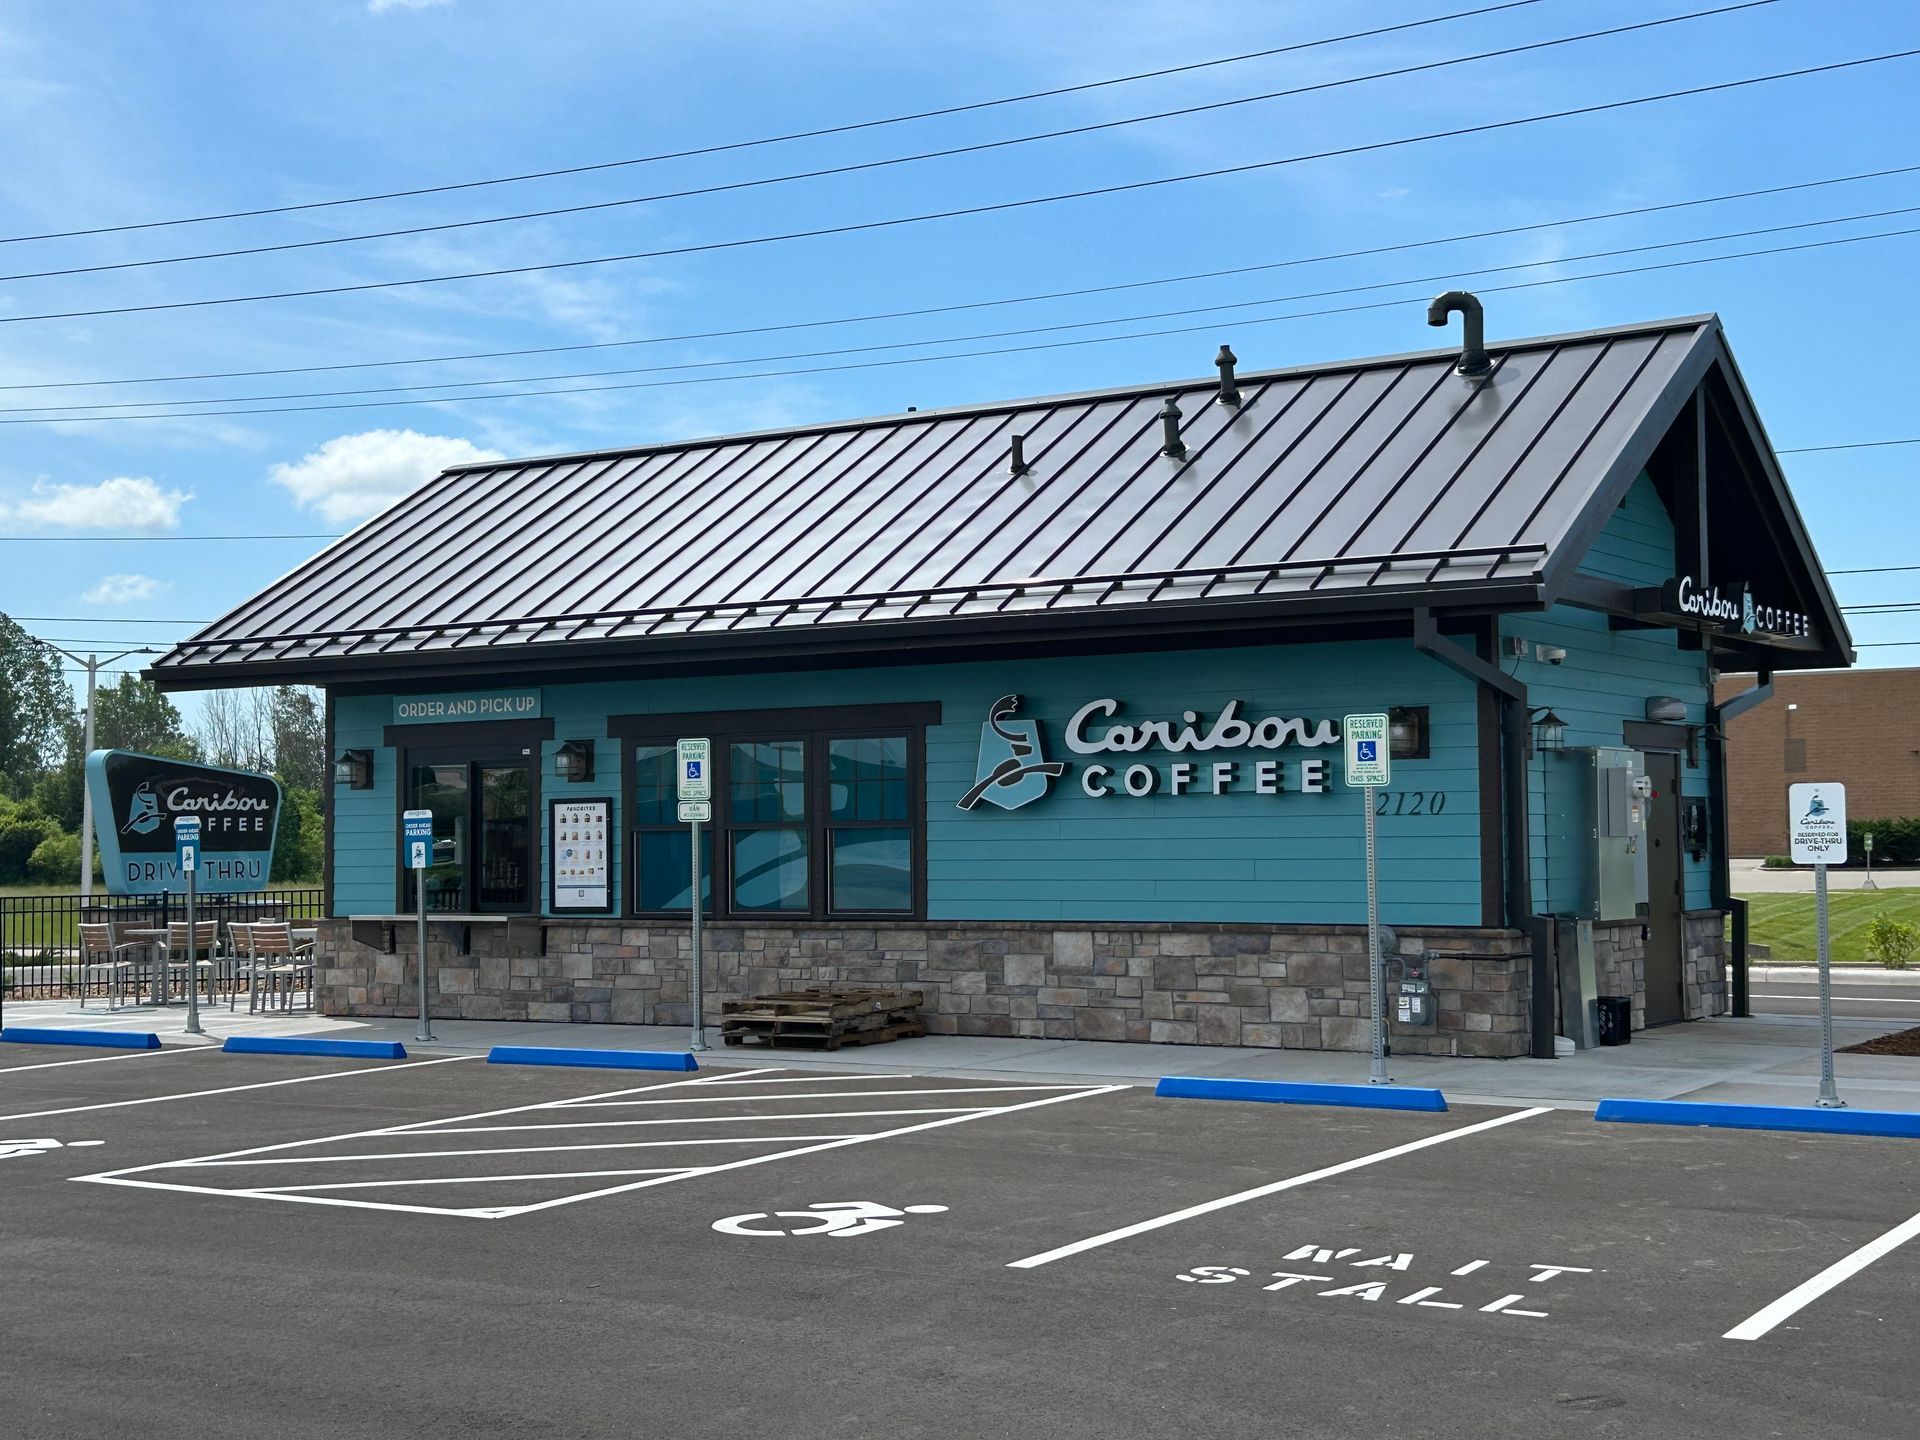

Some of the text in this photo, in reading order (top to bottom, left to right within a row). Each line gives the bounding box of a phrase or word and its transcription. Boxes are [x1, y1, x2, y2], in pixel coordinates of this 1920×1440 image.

[1679, 576, 1808, 636] Caribou COFFEE
[399, 697, 535, 717] ORDER AND PICK UP
[1065, 698, 1340, 754] Caribou
[1350, 719, 1383, 728] RESERVED
[1352, 730, 1382, 739] PARKING
[682, 752, 705, 760] PARKING
[1081, 759, 1324, 797] COFFEE
[167, 787, 270, 811] Caribou
[1375, 791, 1446, 816] 2120
[174, 817, 264, 831] FFEE
[204, 860, 260, 879] THRU
[1282, 1244, 1593, 1282] WAIT
[1176, 1266, 1549, 1317] STALL
